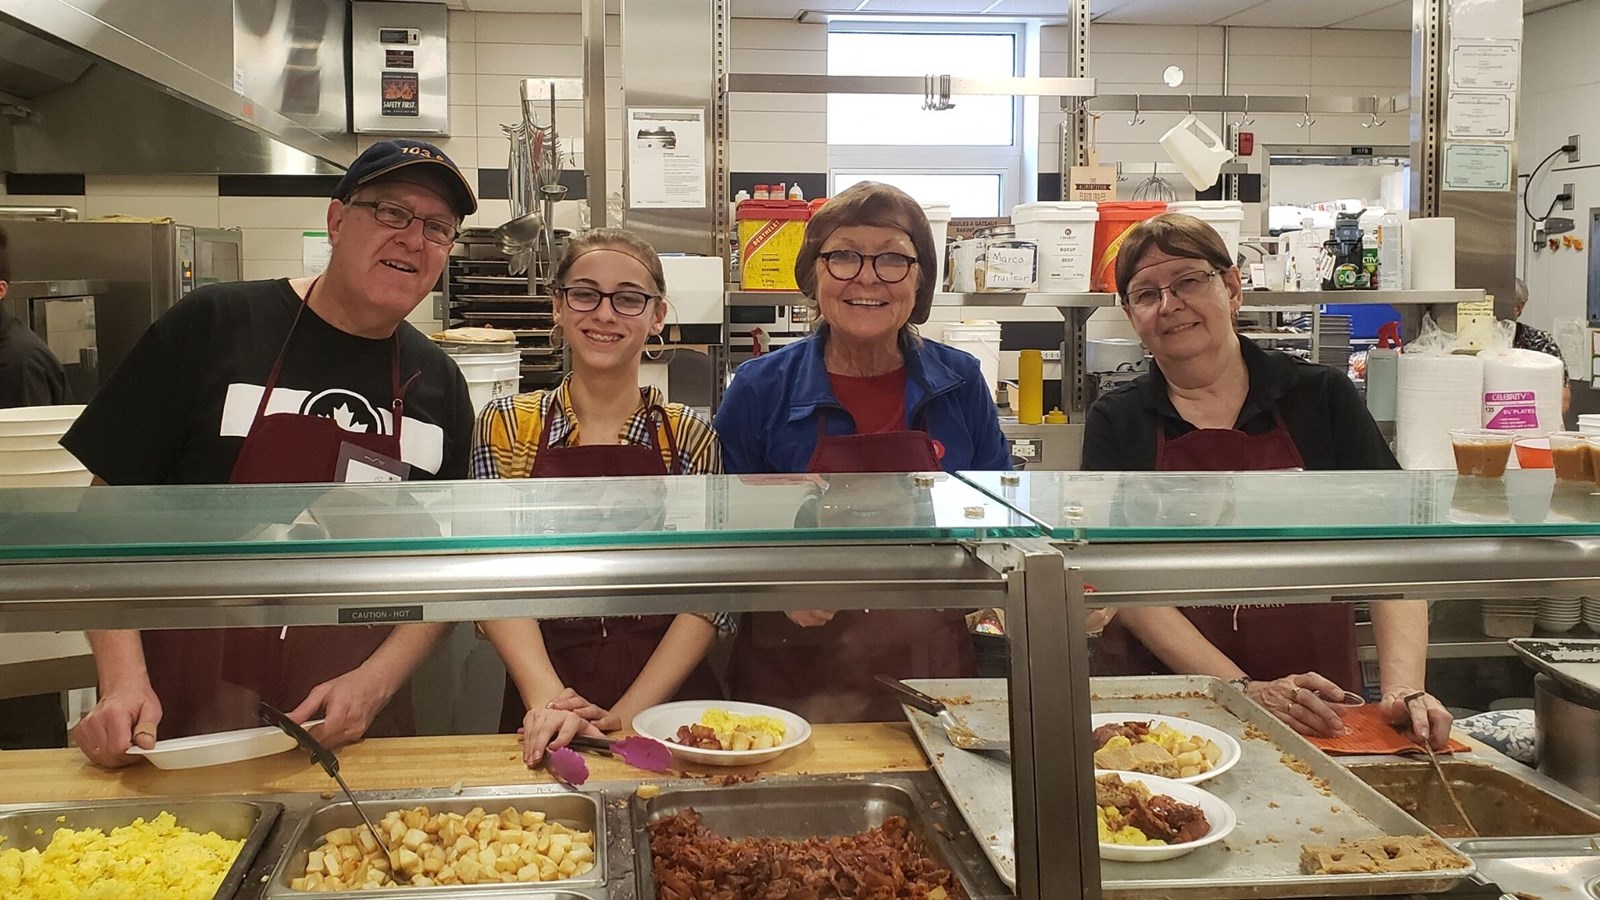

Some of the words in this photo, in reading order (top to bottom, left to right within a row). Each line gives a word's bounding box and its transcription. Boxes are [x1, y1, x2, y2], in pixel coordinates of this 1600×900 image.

[993, 251, 1025, 264] Marco
[1491, 393, 1527, 401] CELEBRITY
[352, 611, 387, 619] CAUTION
[393, 610, 410, 618] HOT
